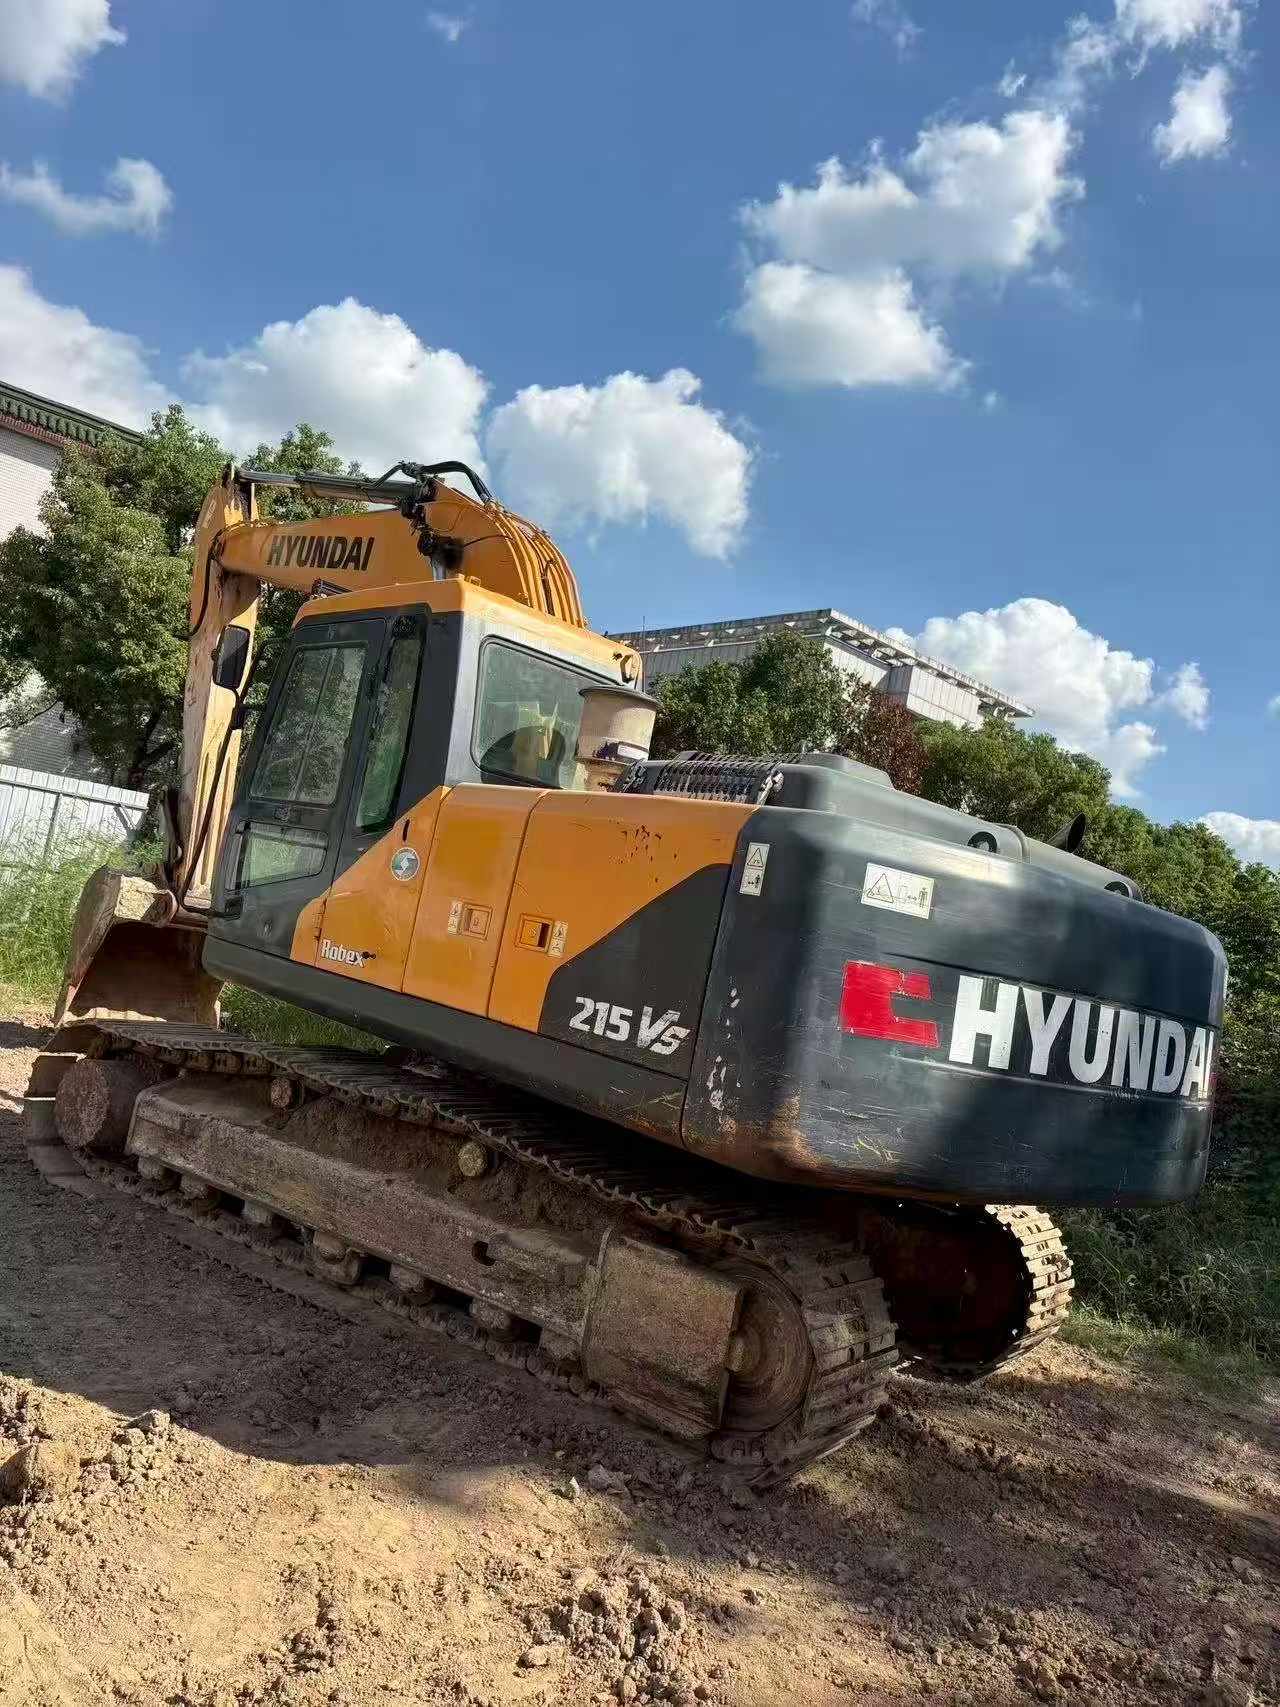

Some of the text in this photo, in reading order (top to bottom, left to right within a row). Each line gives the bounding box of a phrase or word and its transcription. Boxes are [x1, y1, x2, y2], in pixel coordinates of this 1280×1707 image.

[266, 535, 375, 571] HYUNDAI
[321, 938, 366, 968] Robex
[569, 996, 633, 1041] 215
